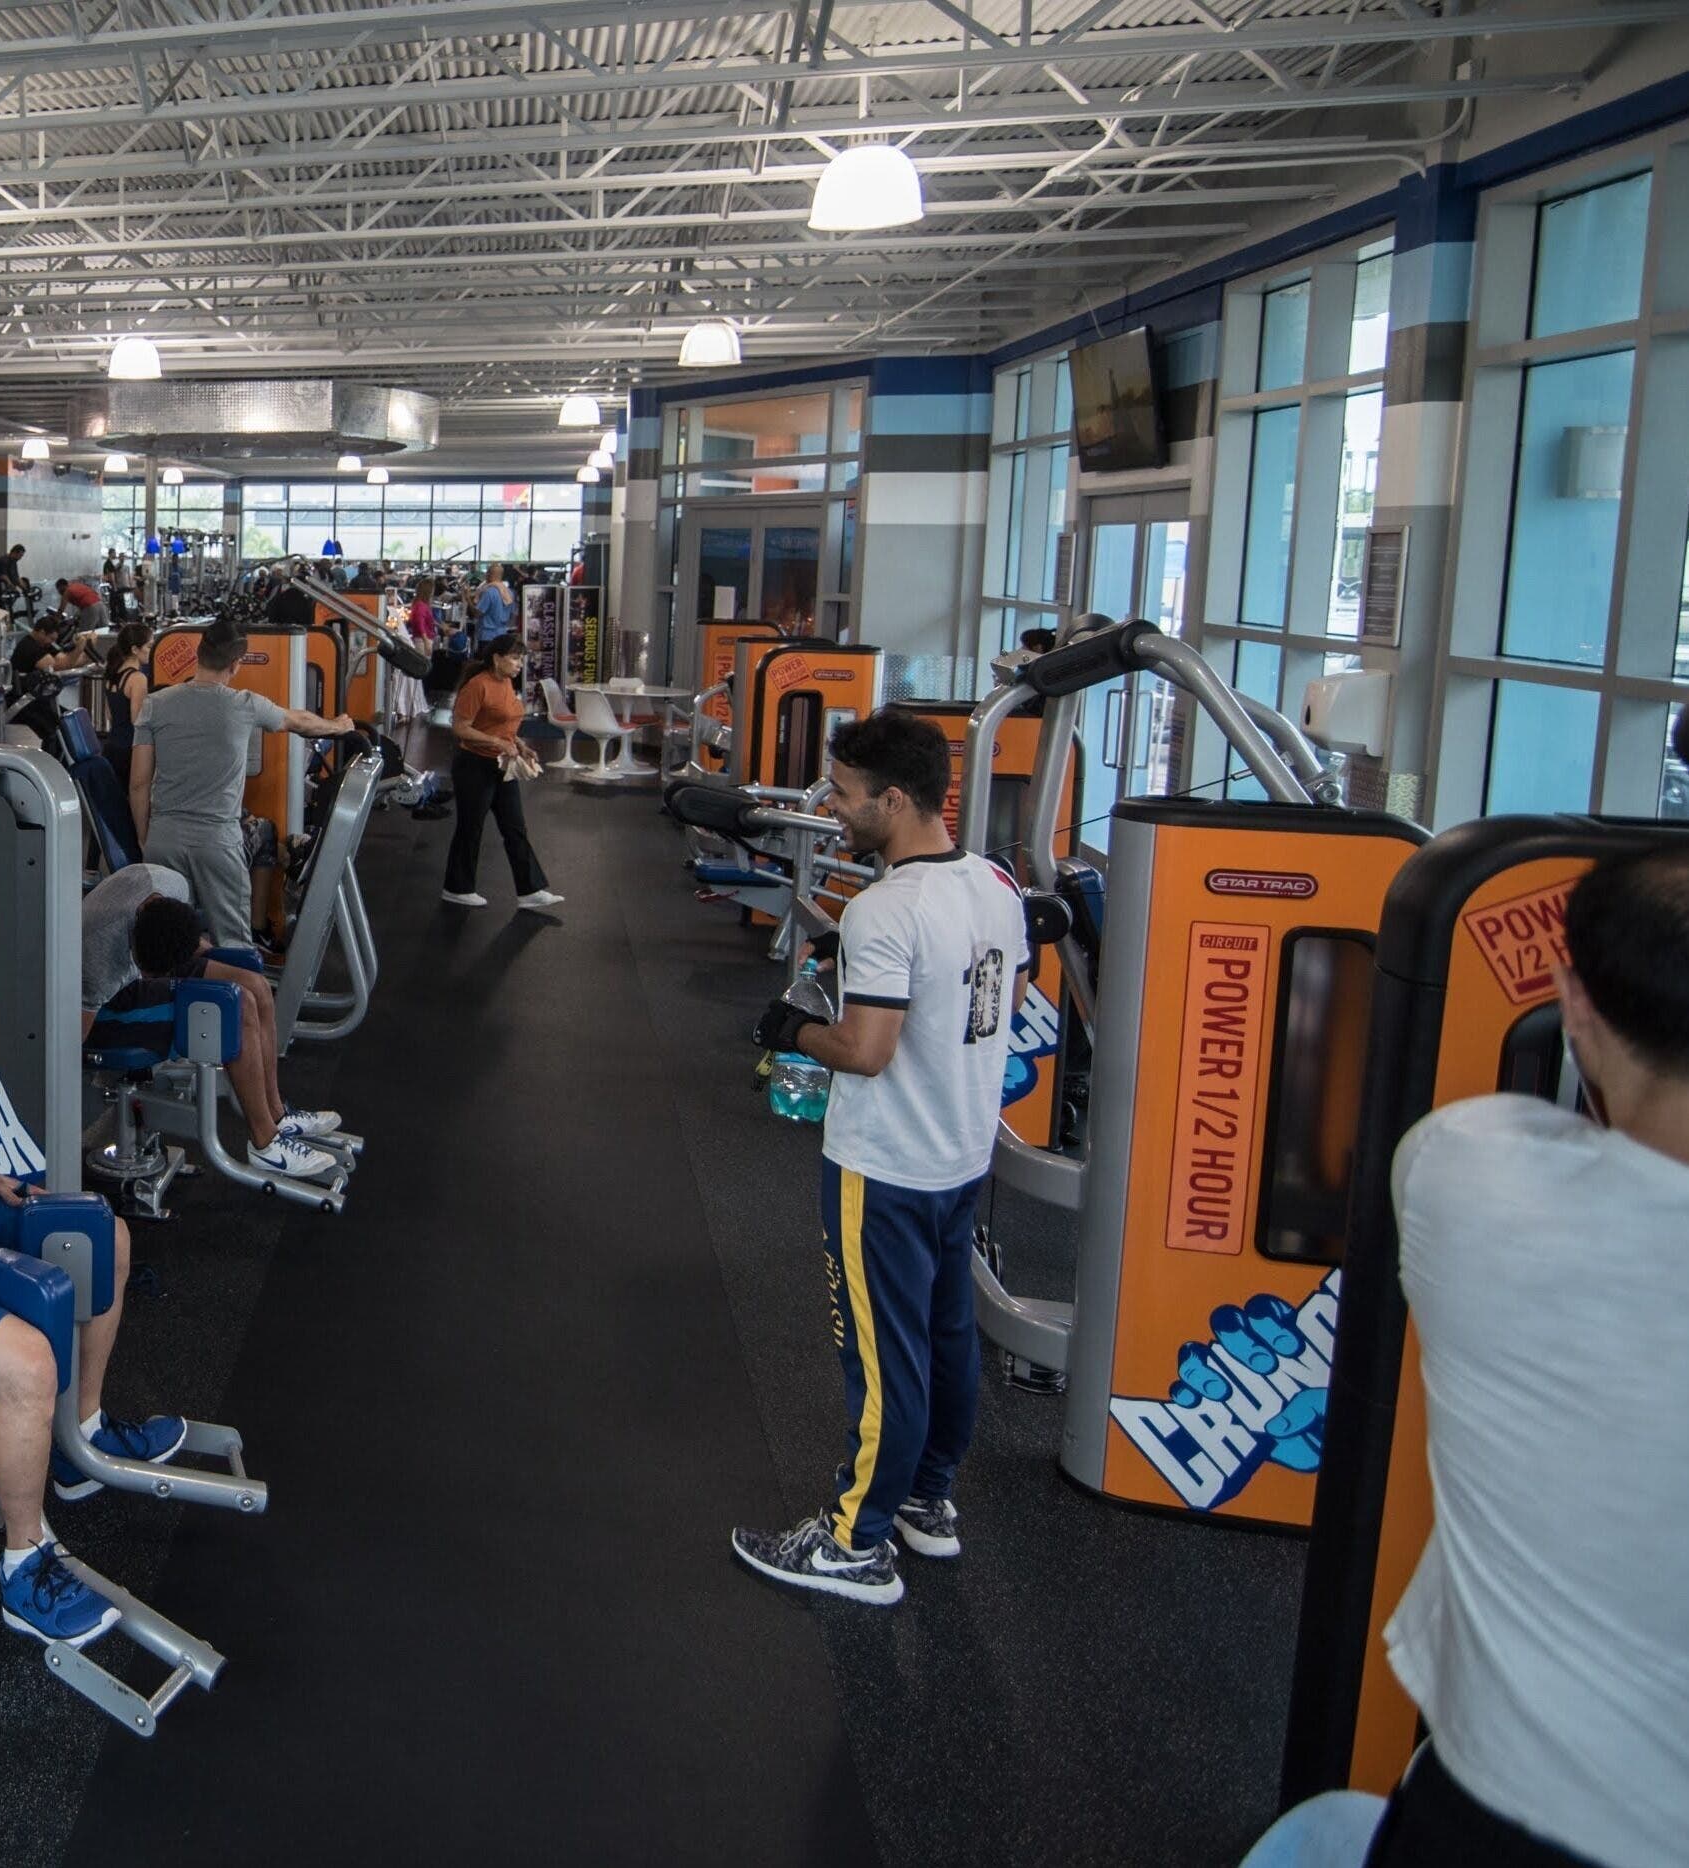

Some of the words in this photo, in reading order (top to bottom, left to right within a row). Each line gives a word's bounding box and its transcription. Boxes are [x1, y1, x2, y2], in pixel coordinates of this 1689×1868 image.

[159, 640, 188, 666] POWER
[584, 617, 597, 660] SERIOUS
[771, 658, 803, 677] POWER
[1214, 877, 1259, 888] STAR
[1260, 879, 1307, 891] TRAC
[1200, 934, 1257, 951] CIRCUIT
[1476, 894, 1568, 951] POW
[1497, 944, 1549, 980] 1/2
[1198, 957, 1251, 1081] POWER
[1194, 1090, 1239, 1140] 1/2
[1185, 1145, 1236, 1241] HOUR
[1109, 1267, 1342, 1509] CRUNC
